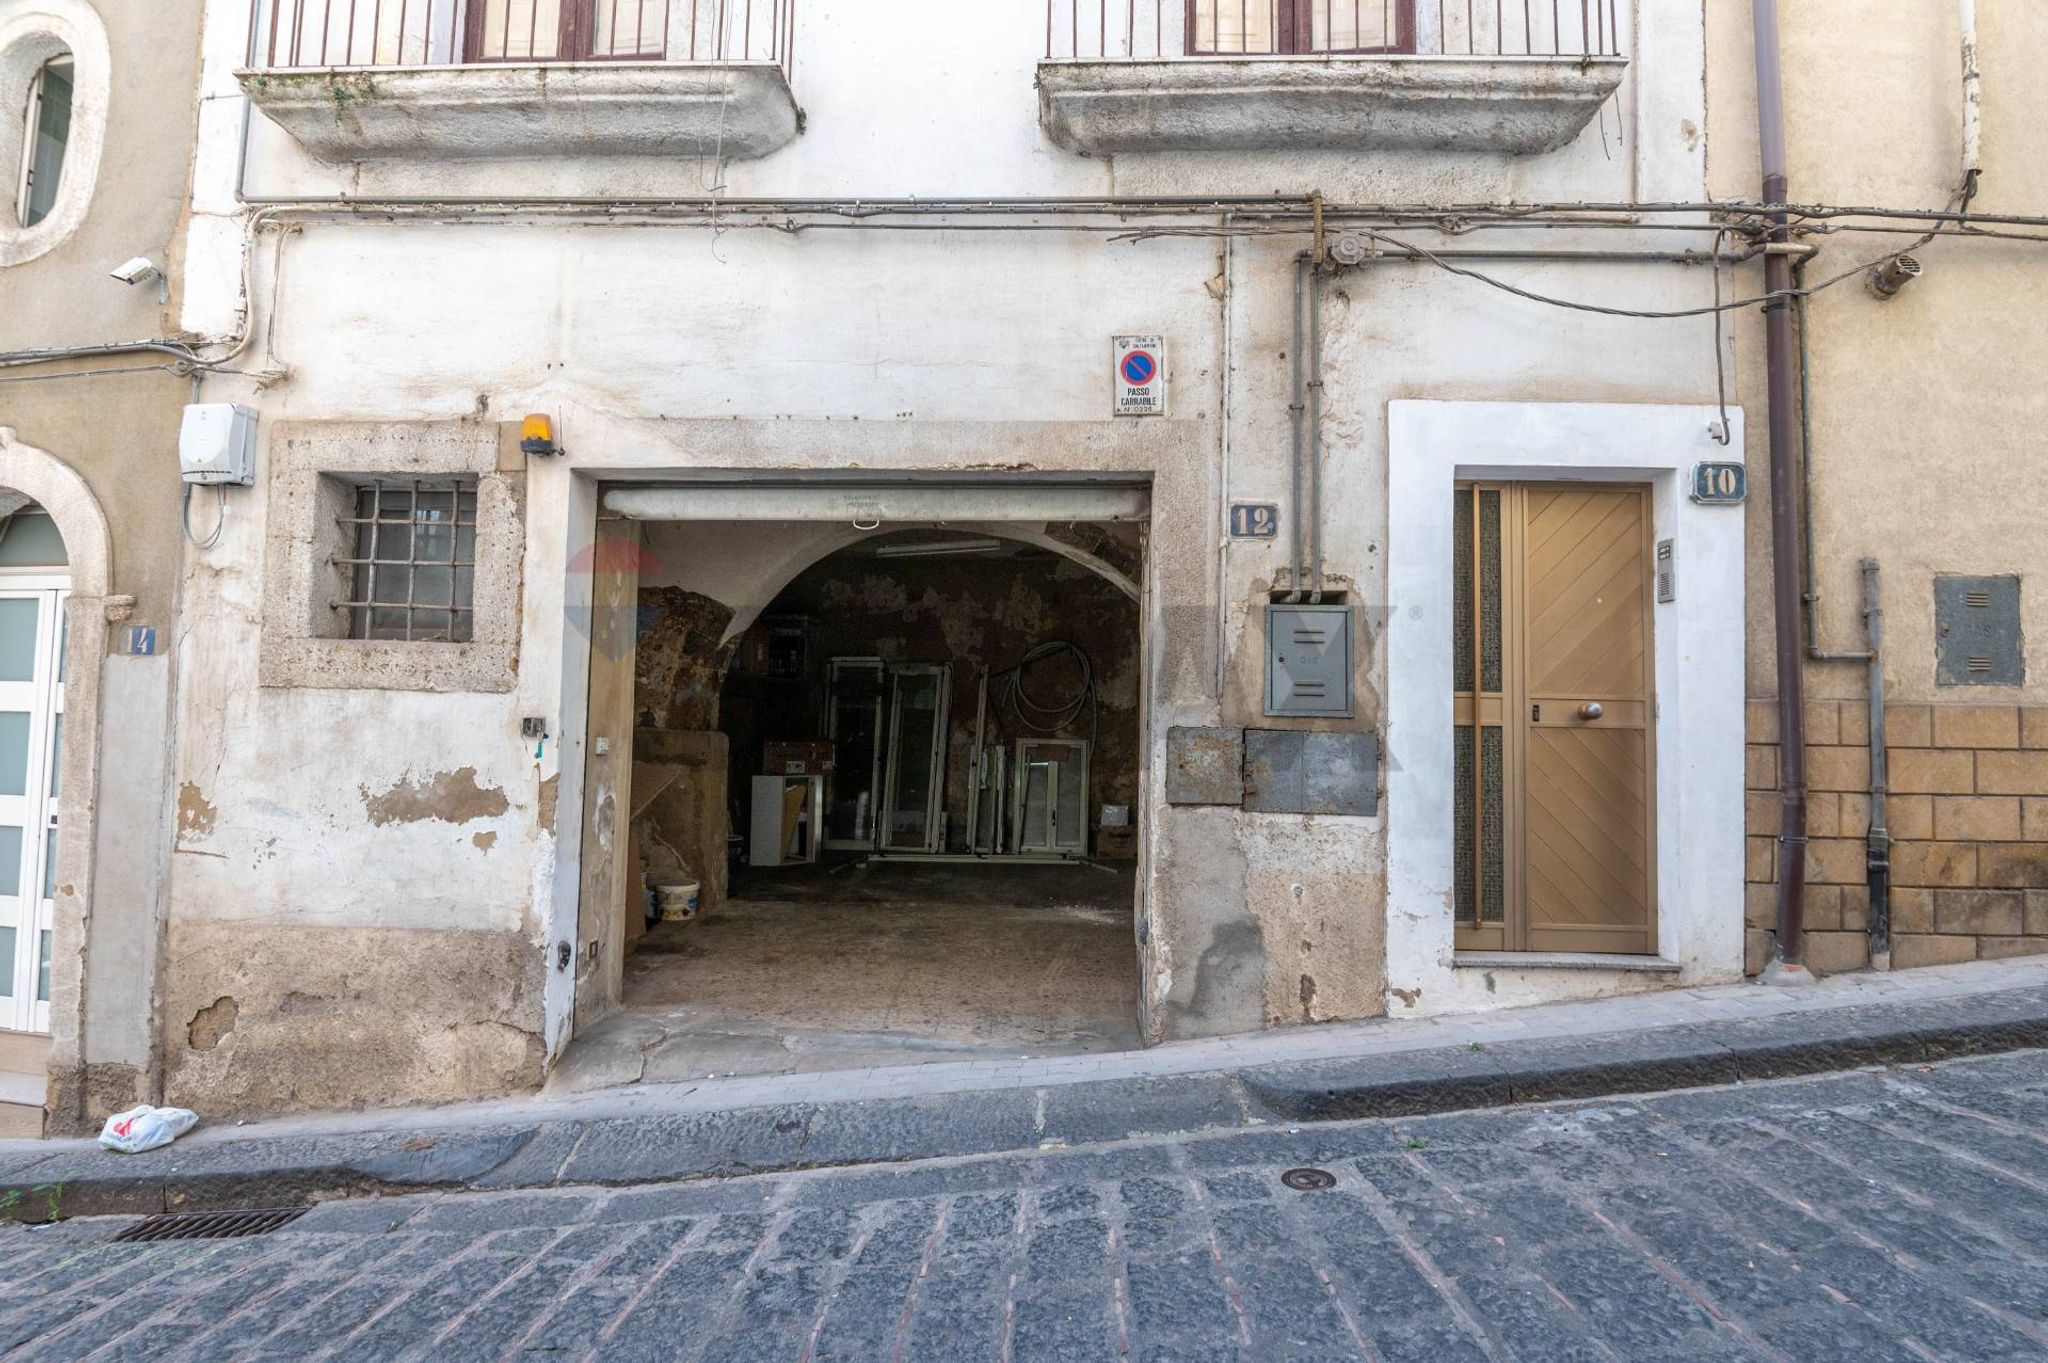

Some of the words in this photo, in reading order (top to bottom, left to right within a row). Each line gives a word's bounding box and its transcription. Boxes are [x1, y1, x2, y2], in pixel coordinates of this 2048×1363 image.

[1127, 387, 1150, 396] PASSO
[1121, 397, 1157, 406] CARRABILE
[1704, 467, 1736, 495] 10
[1238, 508, 1269, 534] 12
